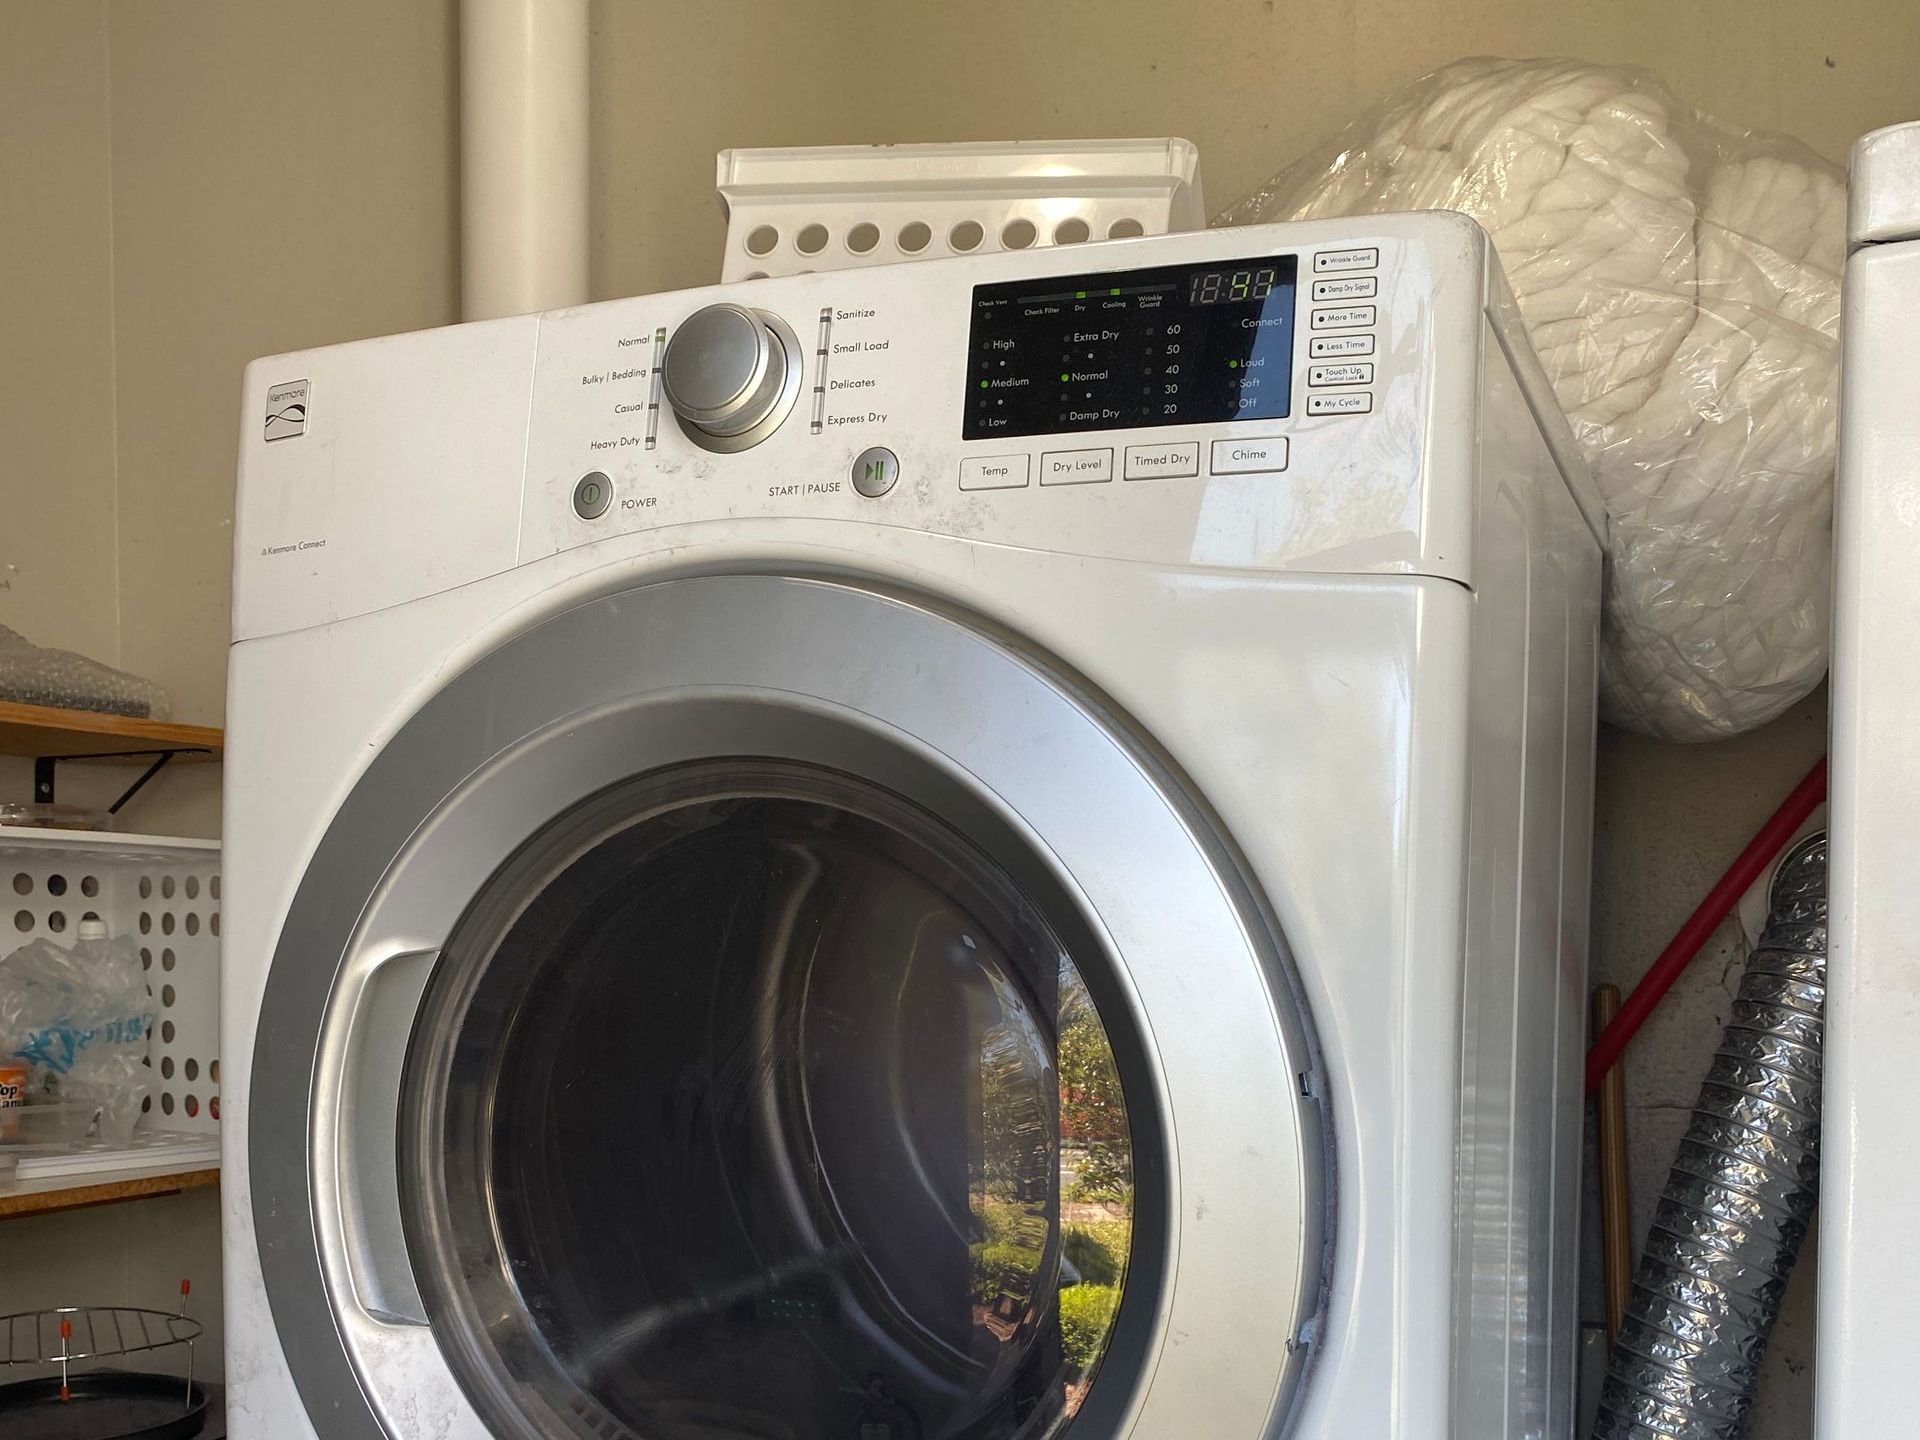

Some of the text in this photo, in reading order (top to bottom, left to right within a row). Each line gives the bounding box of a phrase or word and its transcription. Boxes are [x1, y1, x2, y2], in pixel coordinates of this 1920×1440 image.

[1352, 254, 1370, 262] Guard
[1354, 282, 1370, 292] Signal
[1138, 294, 1162, 302] Wrinkle
[1024, 306, 1060, 316] Check Filter
[1102, 301, 1126, 310] Cooling
[836, 309, 876, 320] Sanitize
[1241, 318, 1282, 328] Connect
[1166, 324, 1180, 335] 60
[618, 334, 650, 348] Normal
[1074, 330, 1120, 342] Extra Dry
[834, 340, 890, 354] Small Load
[992, 340, 1015, 351] High
[1166, 344, 1180, 354] 50
[1326, 342, 1343, 350] Less
[1240, 356, 1265, 368] Loud
[1166, 364, 1180, 374] 40
[1350, 366, 1362, 374] Up
[582, 368, 647, 385] Bulky Bedding
[1072, 370, 1108, 382] Normal
[830, 379, 876, 390] Delicates
[990, 377, 1030, 388] Medium
[1240, 377, 1260, 389] Soft
[1164, 384, 1178, 394] 30
[270, 389, 304, 402] Kenmore
[614, 401, 644, 414] Casual
[1238, 398, 1256, 408] Off
[1324, 398, 1360, 408] My Cycle
[1164, 404, 1177, 414] 20
[828, 412, 888, 427] Express Dry
[1070, 408, 1120, 422] Damp Dry
[988, 418, 1008, 427] Low
[590, 436, 640, 450] Heavy Duty
[1134, 454, 1190, 466] Timed Dry
[1232, 450, 1267, 461] Chime
[981, 466, 1008, 477] Temp
[1053, 459, 1102, 473] Dry Level
[768, 482, 840, 496] START PAUSE
[620, 498, 657, 510] POWER
[268, 540, 326, 556] Kenmore Connect
[0, 1081, 18, 1100] op
